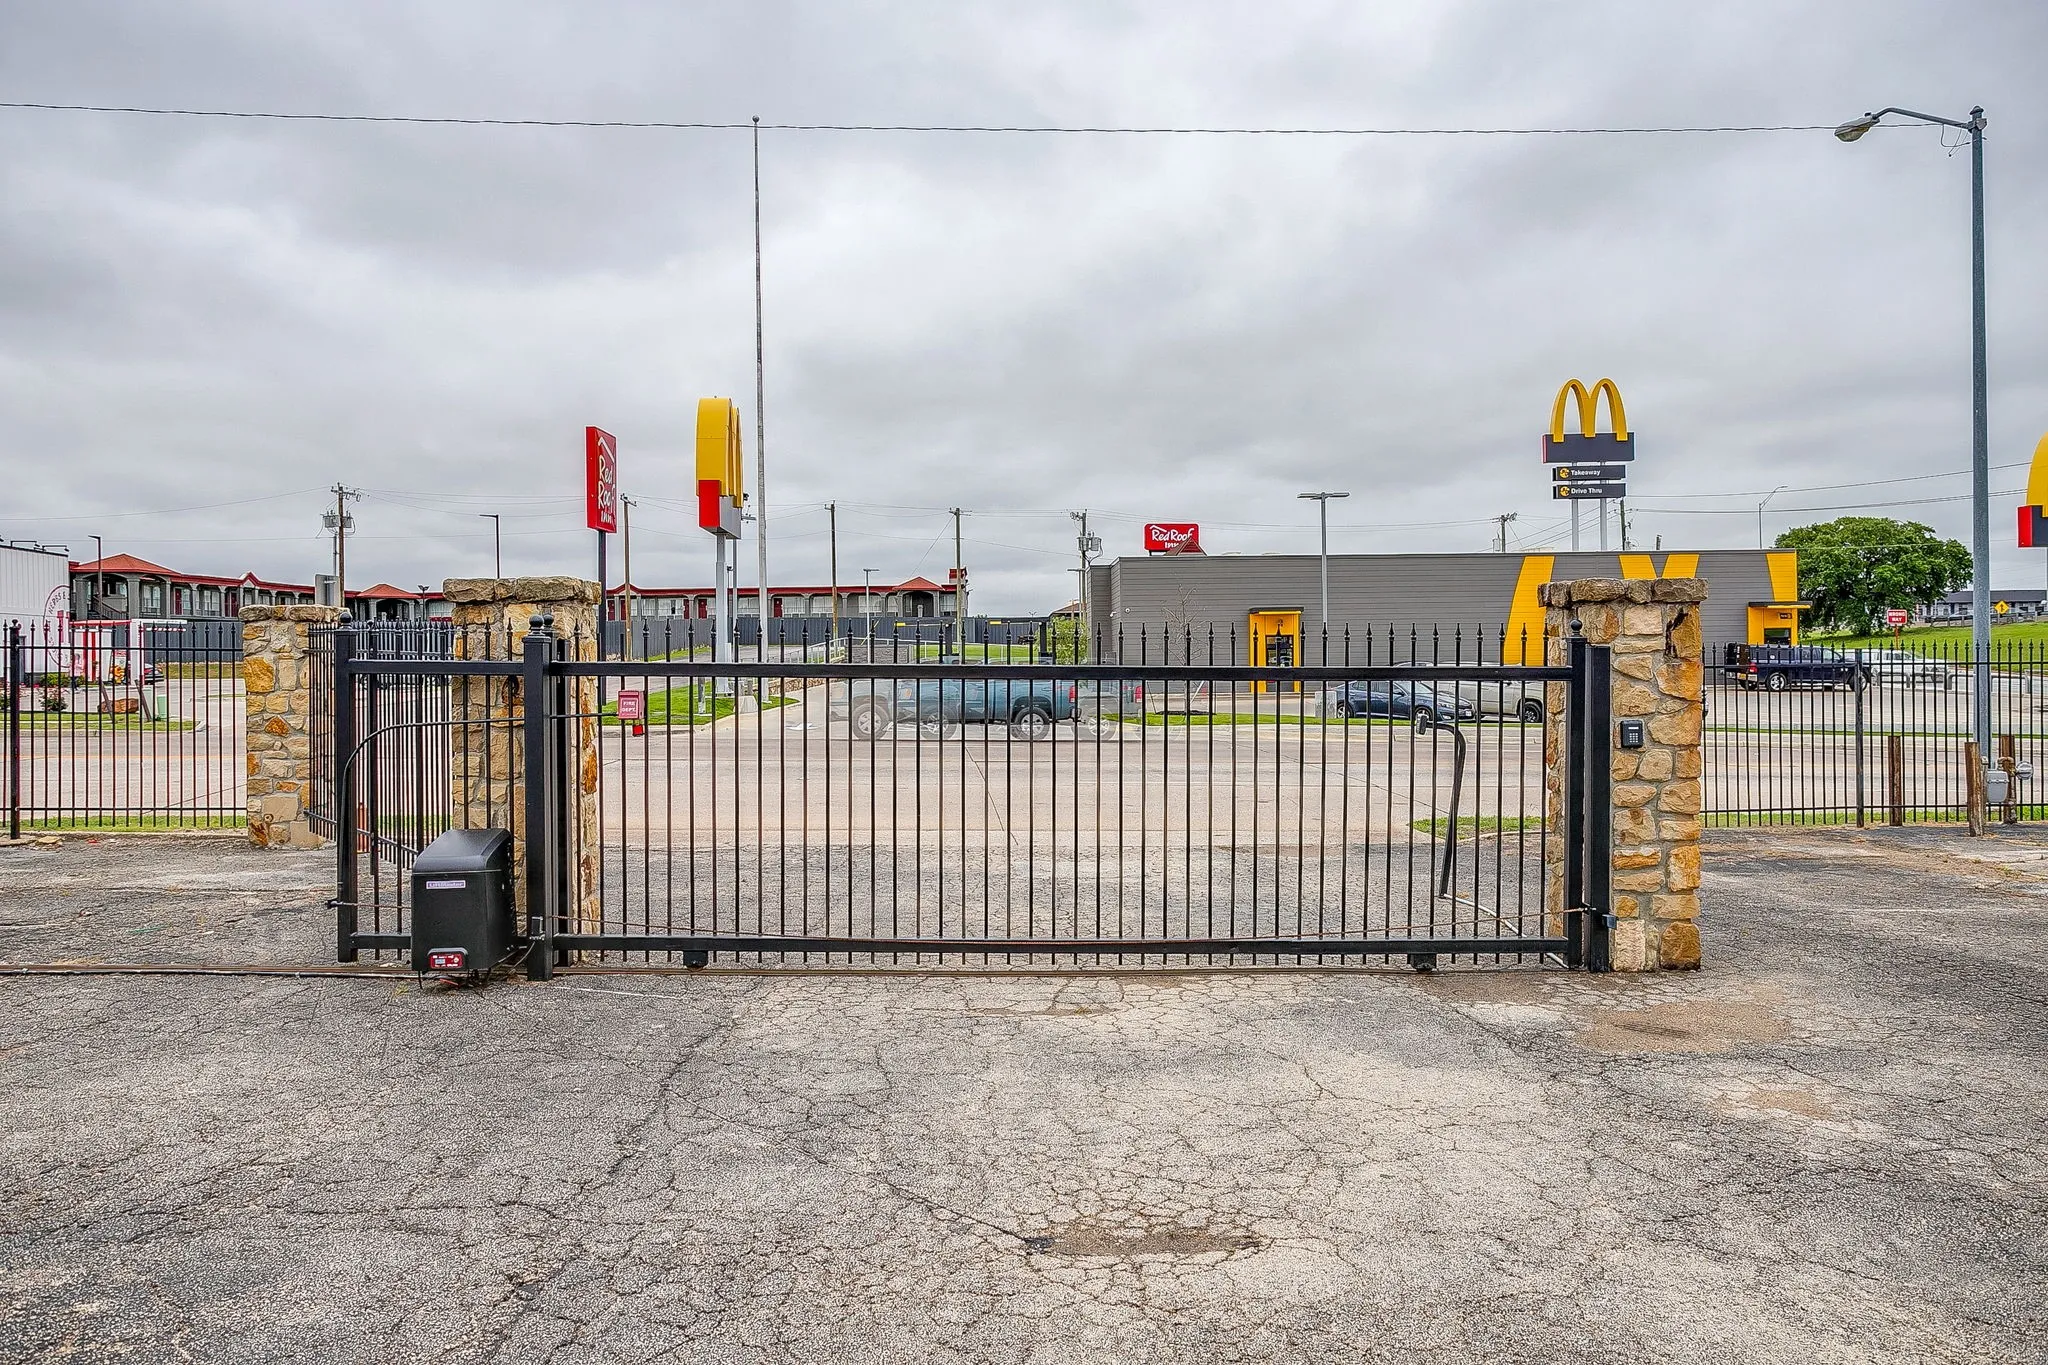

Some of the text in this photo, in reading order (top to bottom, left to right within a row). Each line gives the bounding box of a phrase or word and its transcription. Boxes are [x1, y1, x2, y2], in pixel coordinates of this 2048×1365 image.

[598, 454, 613, 484] Red
[597, 480, 616, 515] Roof
[1571, 487, 1588, 495] Drive
[1151, 528, 1194, 541] Red Roof
